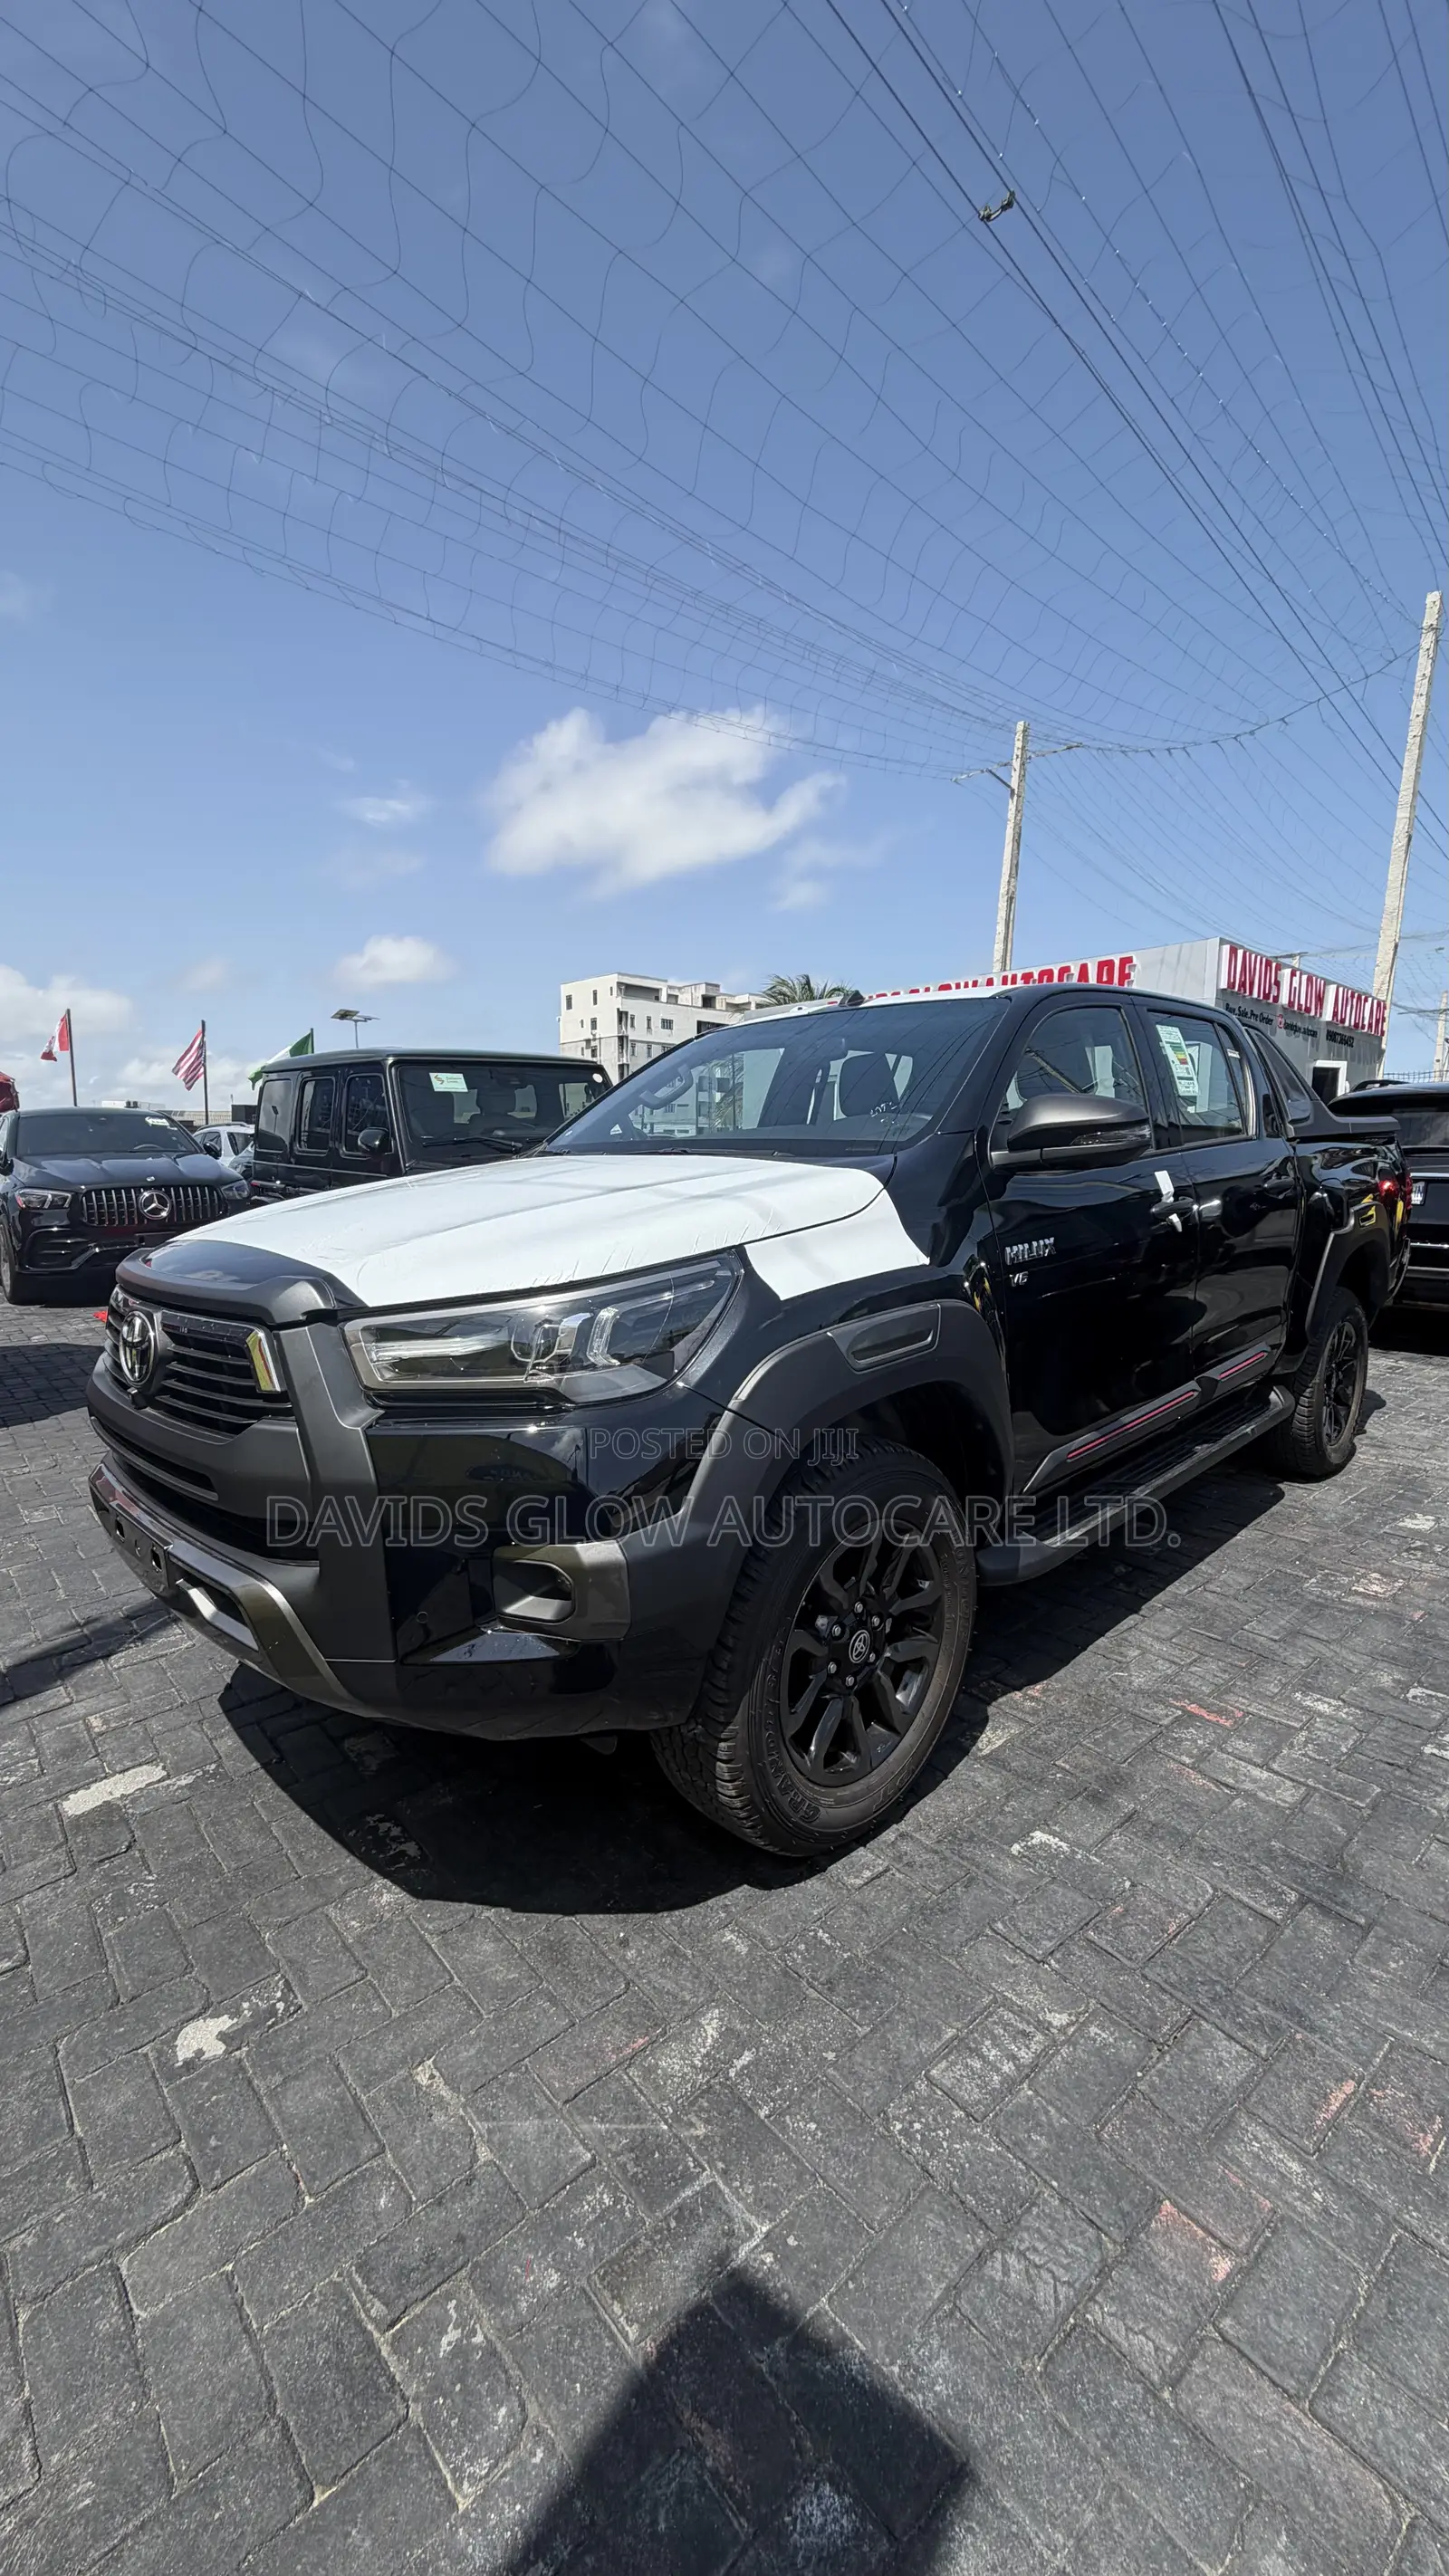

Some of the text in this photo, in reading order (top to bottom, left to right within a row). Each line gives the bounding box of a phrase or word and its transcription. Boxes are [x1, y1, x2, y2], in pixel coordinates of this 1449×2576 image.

[1224, 943, 1387, 1037] DAVIDS GLOW AUTOCARE
